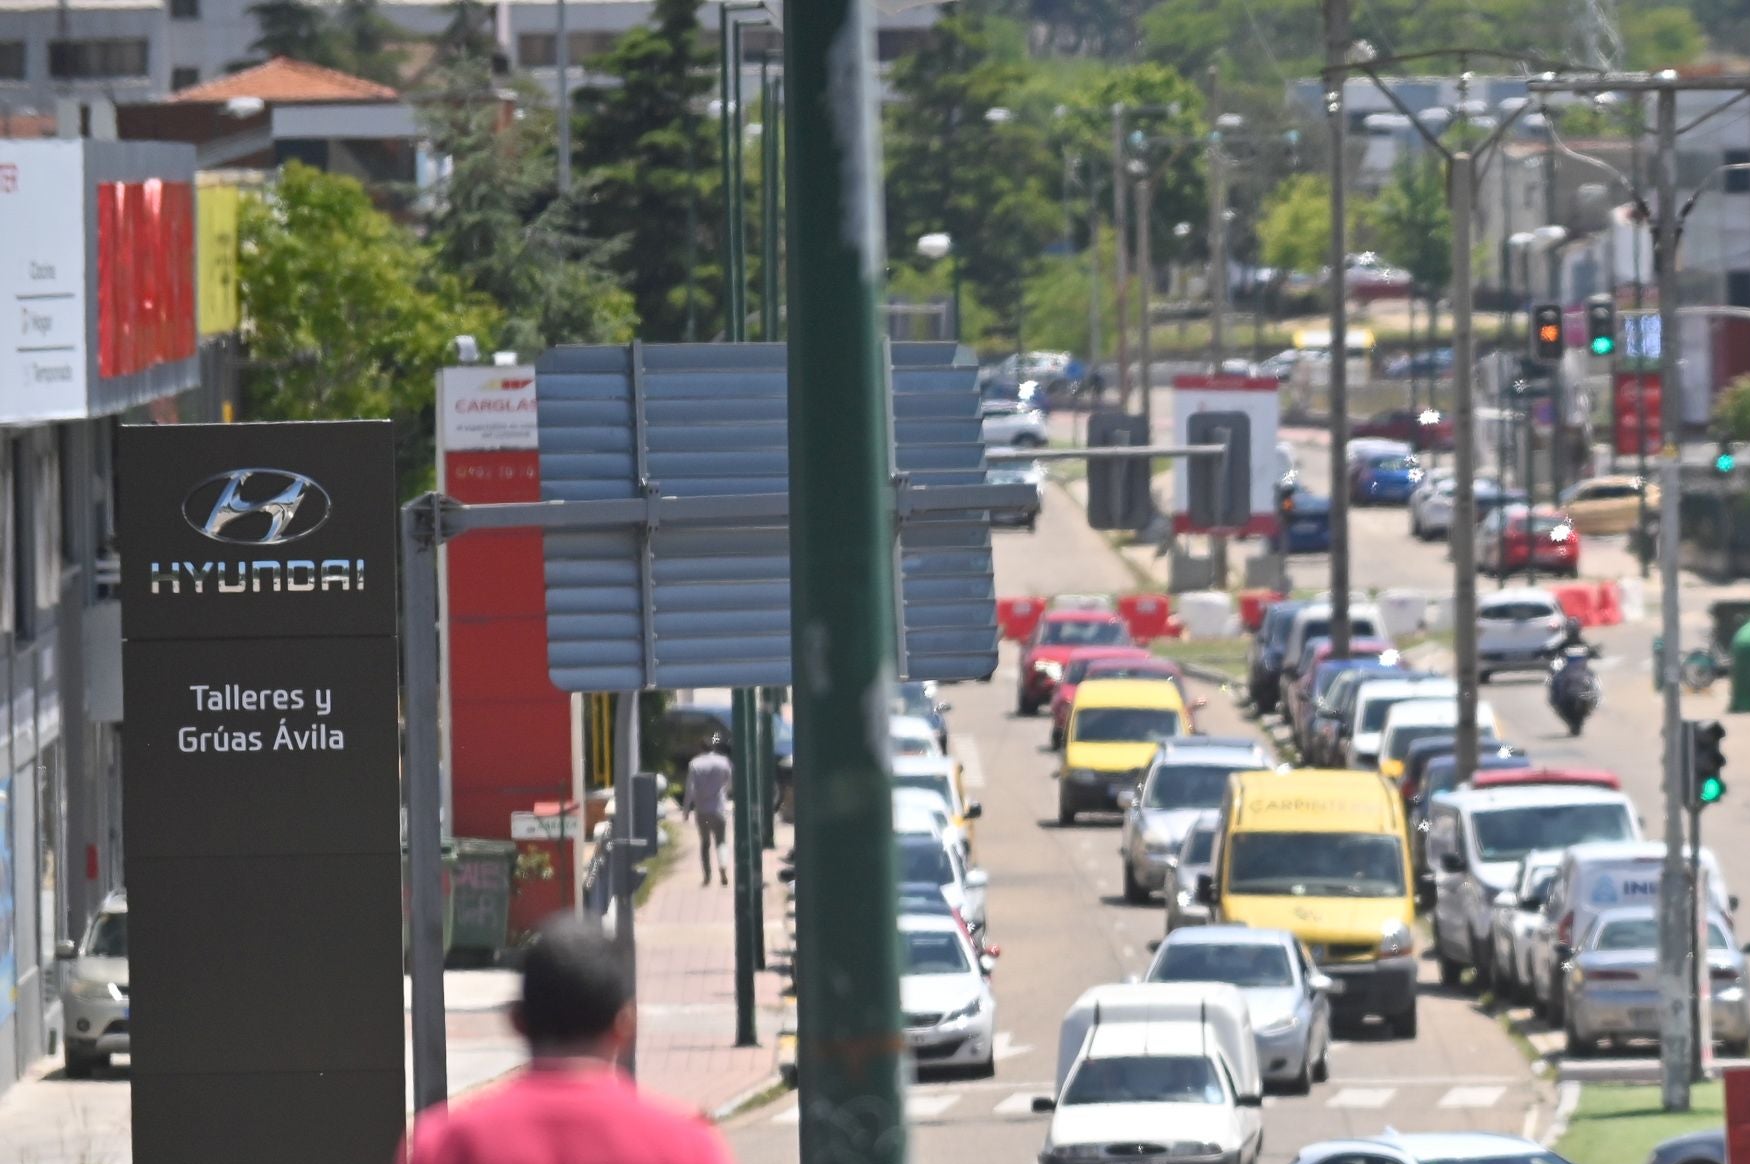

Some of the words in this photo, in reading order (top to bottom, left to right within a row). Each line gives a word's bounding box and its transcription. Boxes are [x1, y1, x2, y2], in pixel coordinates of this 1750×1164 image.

[151, 559, 364, 594] HYUNDAI
[189, 684, 304, 711] Talleres
[315, 688, 332, 716] y
[178, 725, 262, 753] Grúas
[273, 718, 344, 750] Ávila
